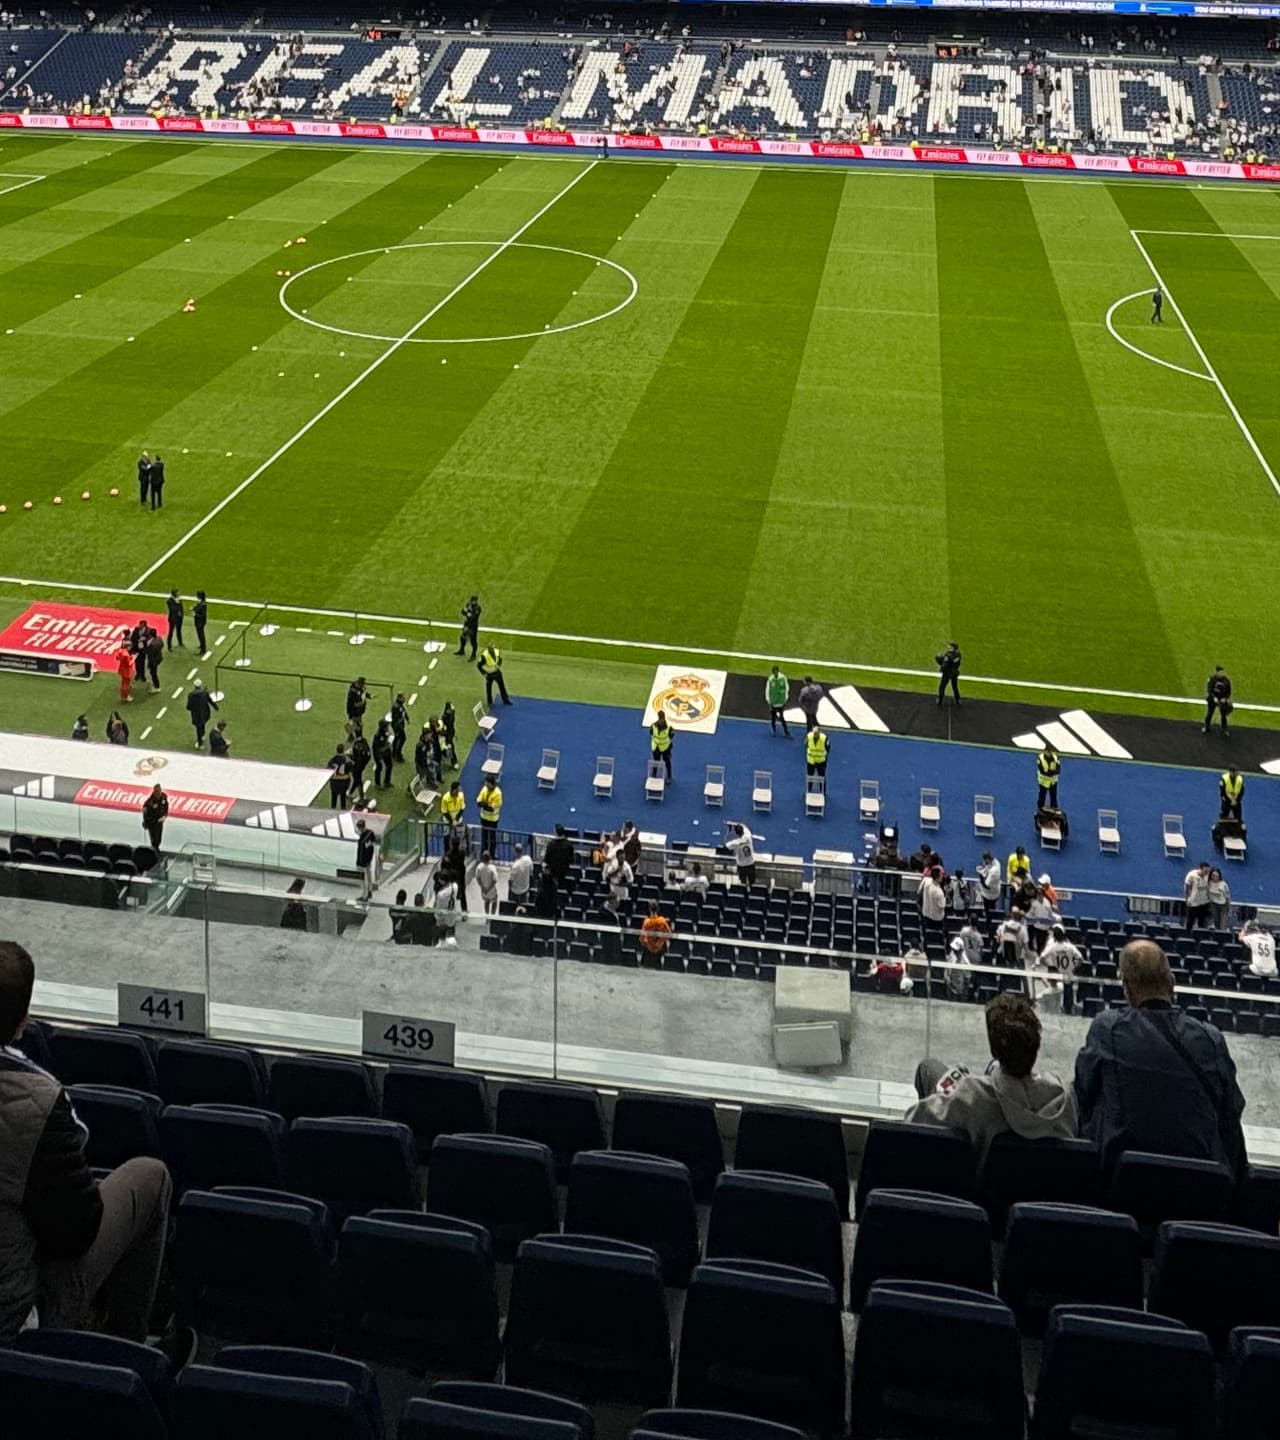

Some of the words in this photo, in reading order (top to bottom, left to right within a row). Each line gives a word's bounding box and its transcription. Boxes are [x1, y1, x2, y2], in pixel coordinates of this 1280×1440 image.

[126, 40, 513, 116] REAL
[560, 51, 1196, 145] MADRID
[922, 149, 960, 161] Emirates
[1027, 153, 1067, 166] Emirates
[1137, 160, 1177, 173] Emirates
[24, 632, 58, 649] FLY
[55, 636, 123, 655] BETTER
[182, 797, 228, 816] BETTER
[140, 995, 184, 1021] 441
[384, 1024, 434, 1050] 439
